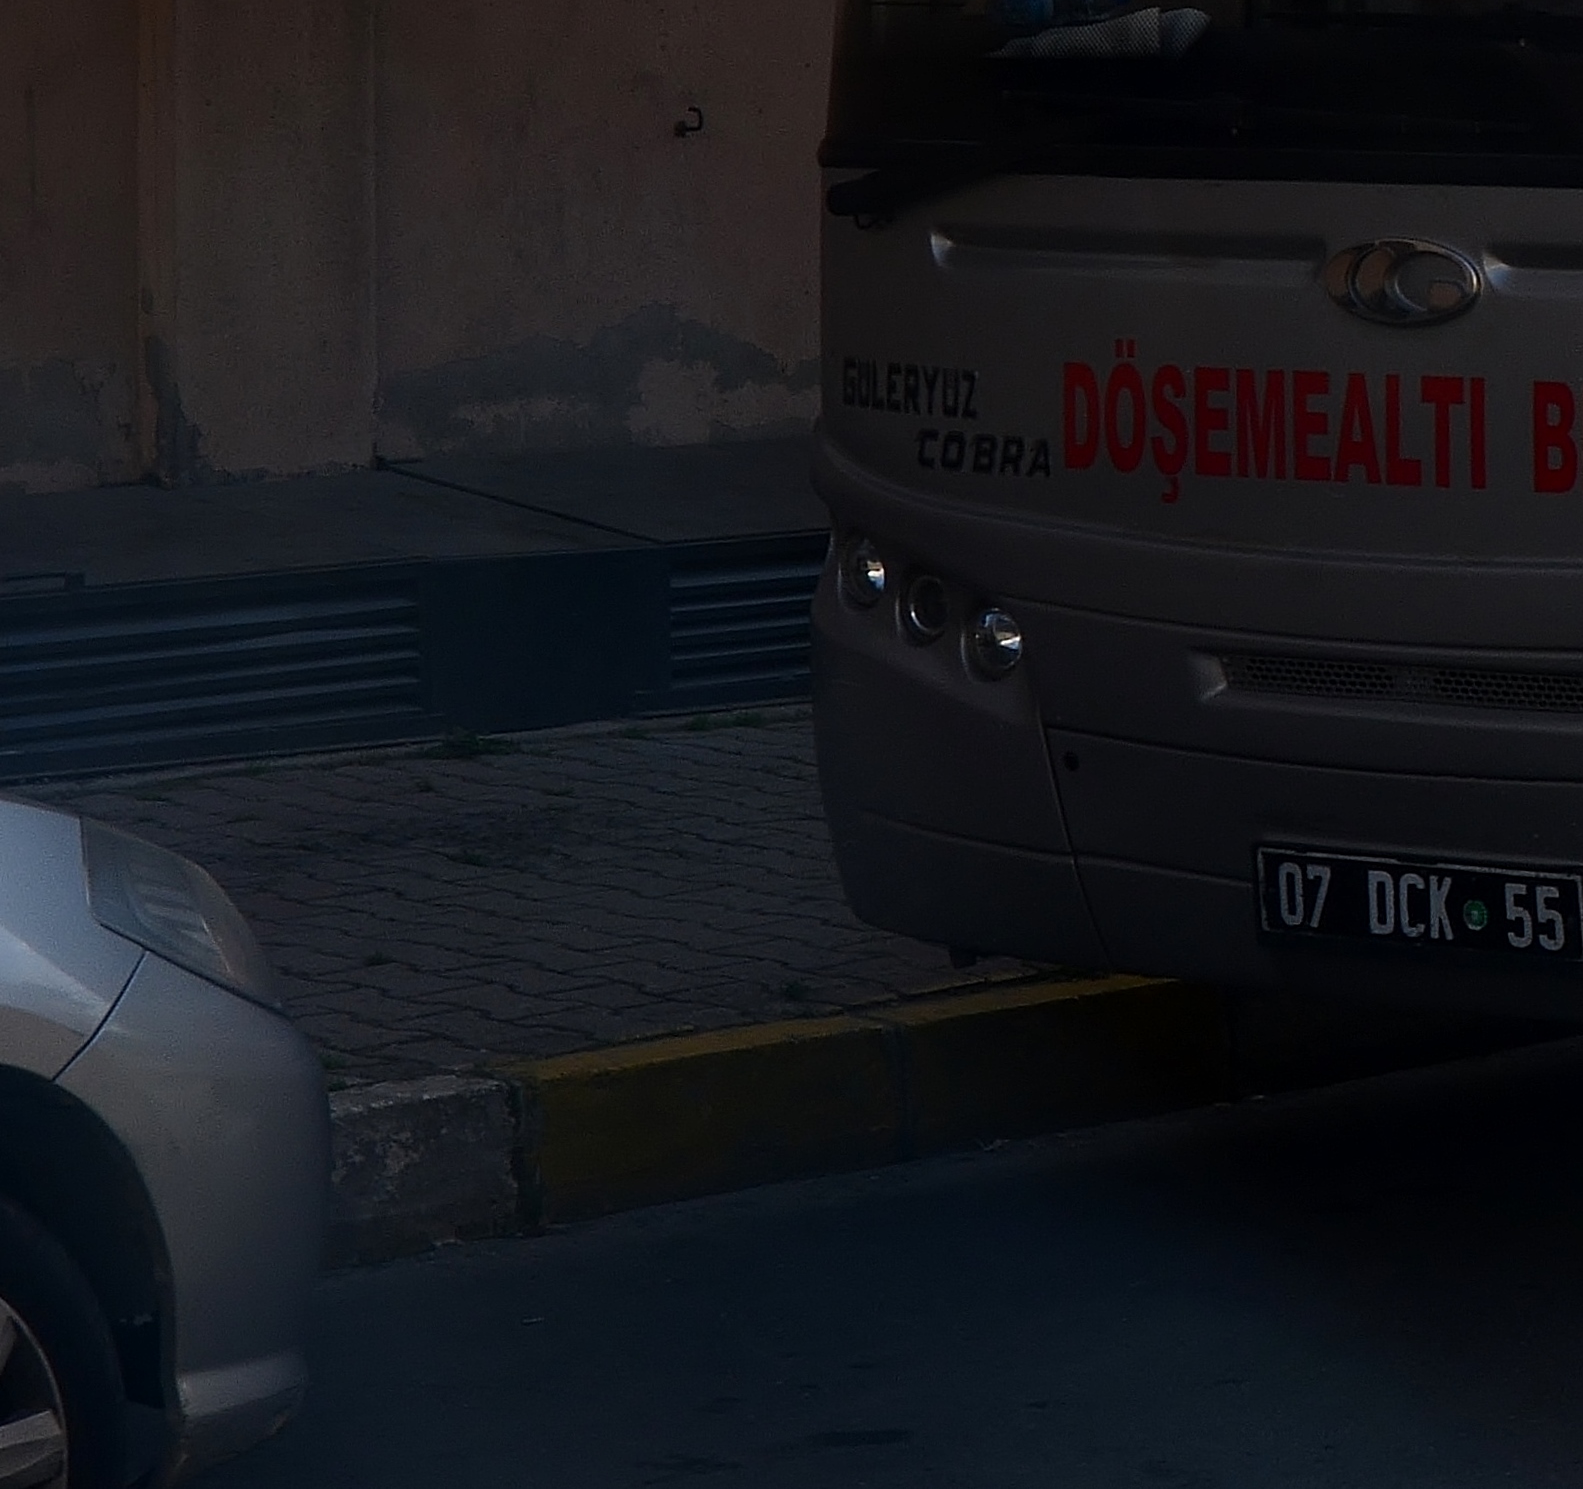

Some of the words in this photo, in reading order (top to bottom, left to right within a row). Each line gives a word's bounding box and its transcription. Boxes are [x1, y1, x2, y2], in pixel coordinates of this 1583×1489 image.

[915, 432, 1051, 478] COBRA
[1062, 339, 1487, 504] DÖŞEMEALTI
[1277, 861, 1332, 928] 07
[1367, 869, 1455, 941] DCK
[1503, 881, 1566, 952] 55
